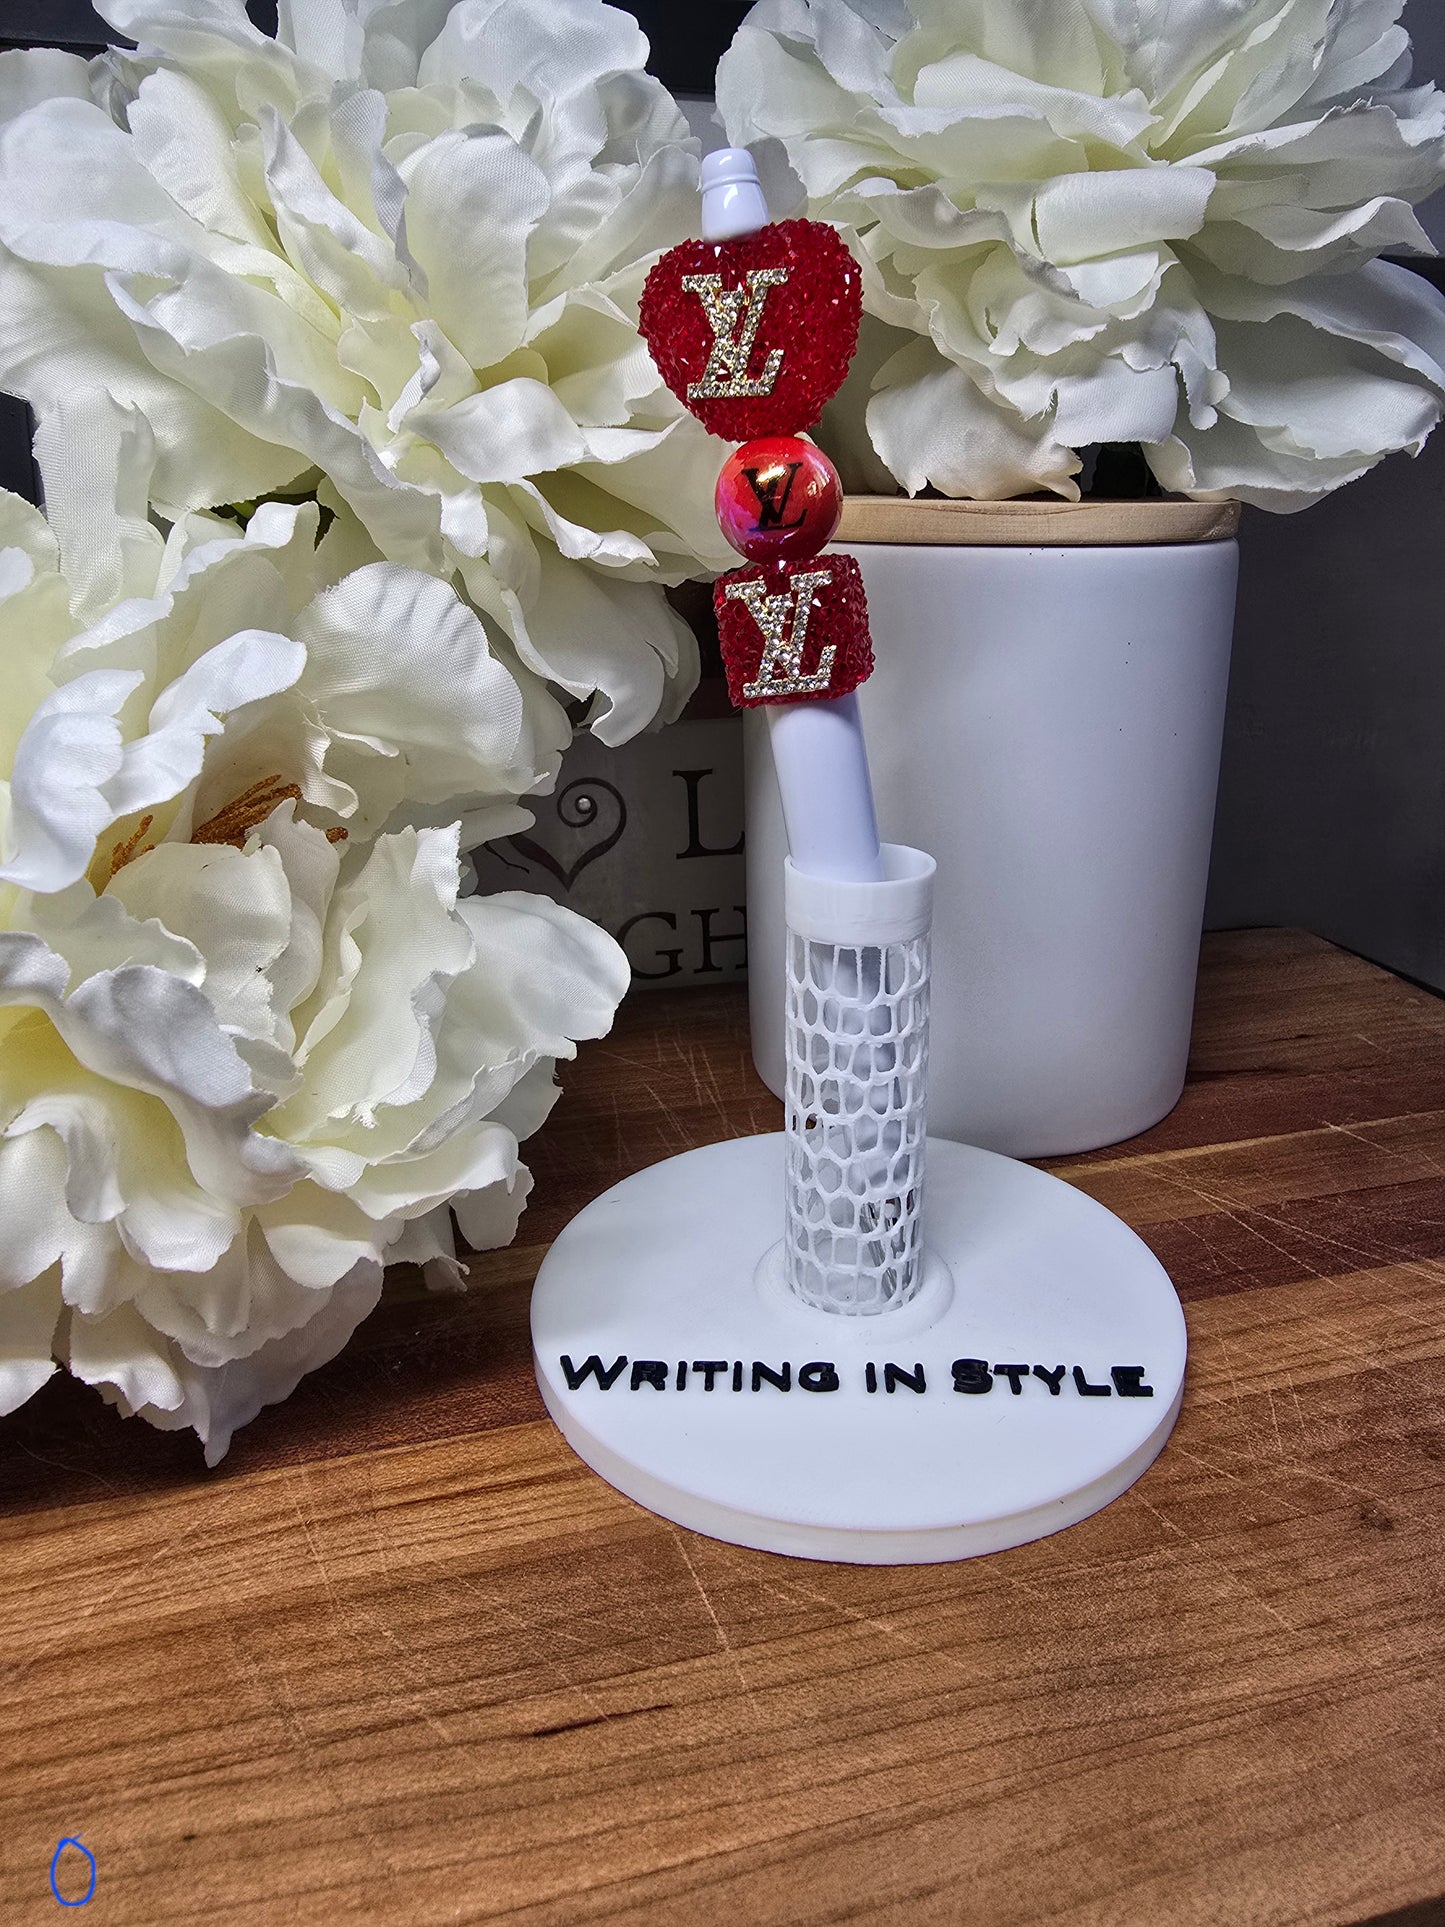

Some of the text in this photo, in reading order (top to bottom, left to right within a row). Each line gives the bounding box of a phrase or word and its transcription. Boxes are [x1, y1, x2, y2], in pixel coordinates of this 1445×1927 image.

[559, 1354, 1154, 1397] WRITING IN STYLE
